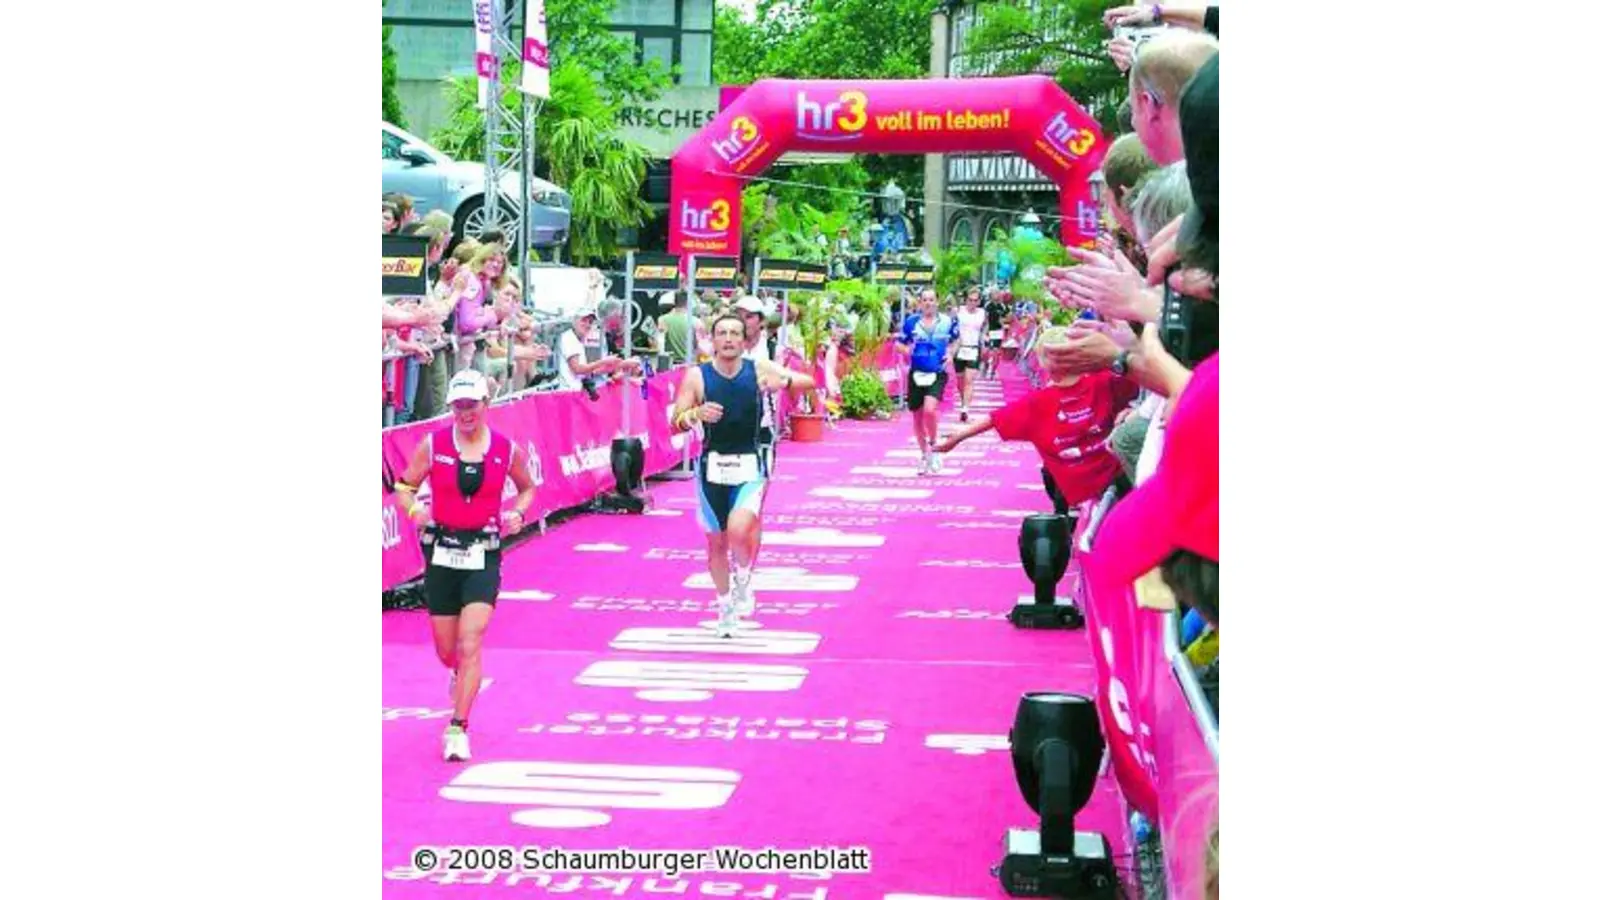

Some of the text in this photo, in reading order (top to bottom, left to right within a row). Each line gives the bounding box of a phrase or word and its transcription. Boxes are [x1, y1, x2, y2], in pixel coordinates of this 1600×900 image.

[797, 90, 868, 131] hr3
[875, 108, 1010, 130] voll im leben!
[711, 115, 758, 163] hr3
[1044, 110, 1096, 156] hr3
[681, 199, 730, 230] hr3
